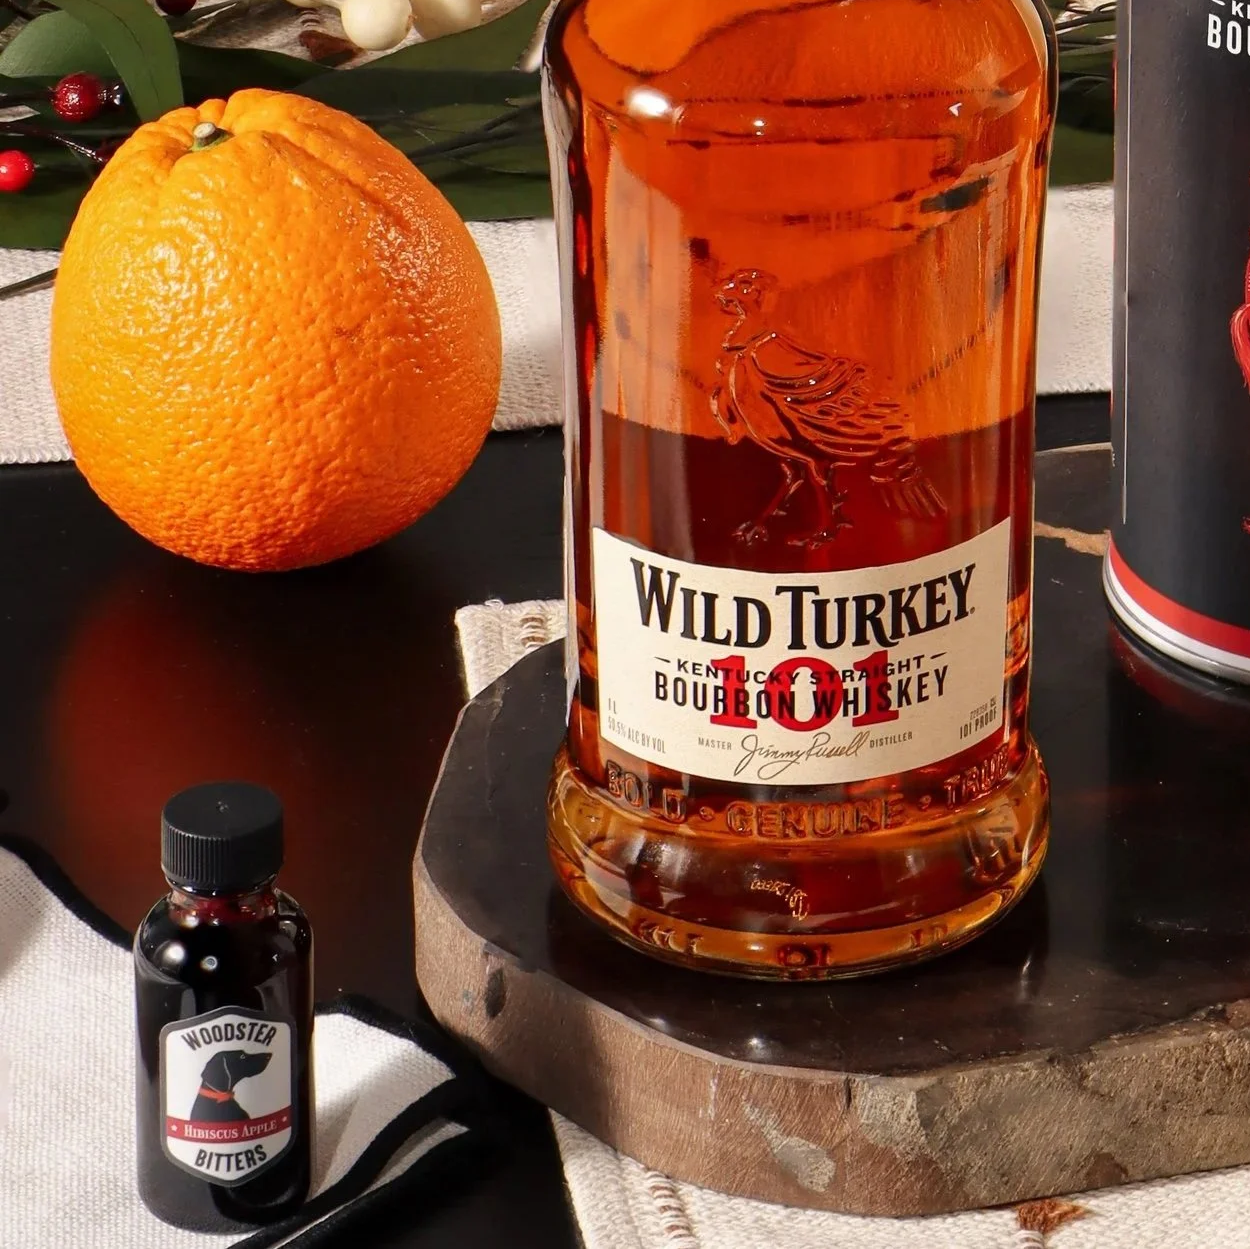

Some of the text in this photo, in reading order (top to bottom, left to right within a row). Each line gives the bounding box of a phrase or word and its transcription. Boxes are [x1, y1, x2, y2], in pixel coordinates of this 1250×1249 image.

[630, 557, 976, 650] WILD TURKEY
[677, 654, 925, 685] KENTUCKY STRAIGHT
[655, 670, 795, 719] BOURBON
[814, 665, 948, 719] WHISKEY
[710, 650, 899, 732] 101
[975, 706, 996, 732] PROOF
[628, 727, 640, 744] ALC
[641, 733, 650, 748] BY
[652, 737, 666, 754] VOL
[698, 736, 732, 751] MASTER
[870, 731, 913, 749] DISTILLER
[725, 793, 905, 840] GENUINE
[181, 1022, 277, 1051] WOODSTER
[184, 1119, 277, 1139] HIBISCUS APPLE
[195, 1144, 267, 1173] BITTERS
